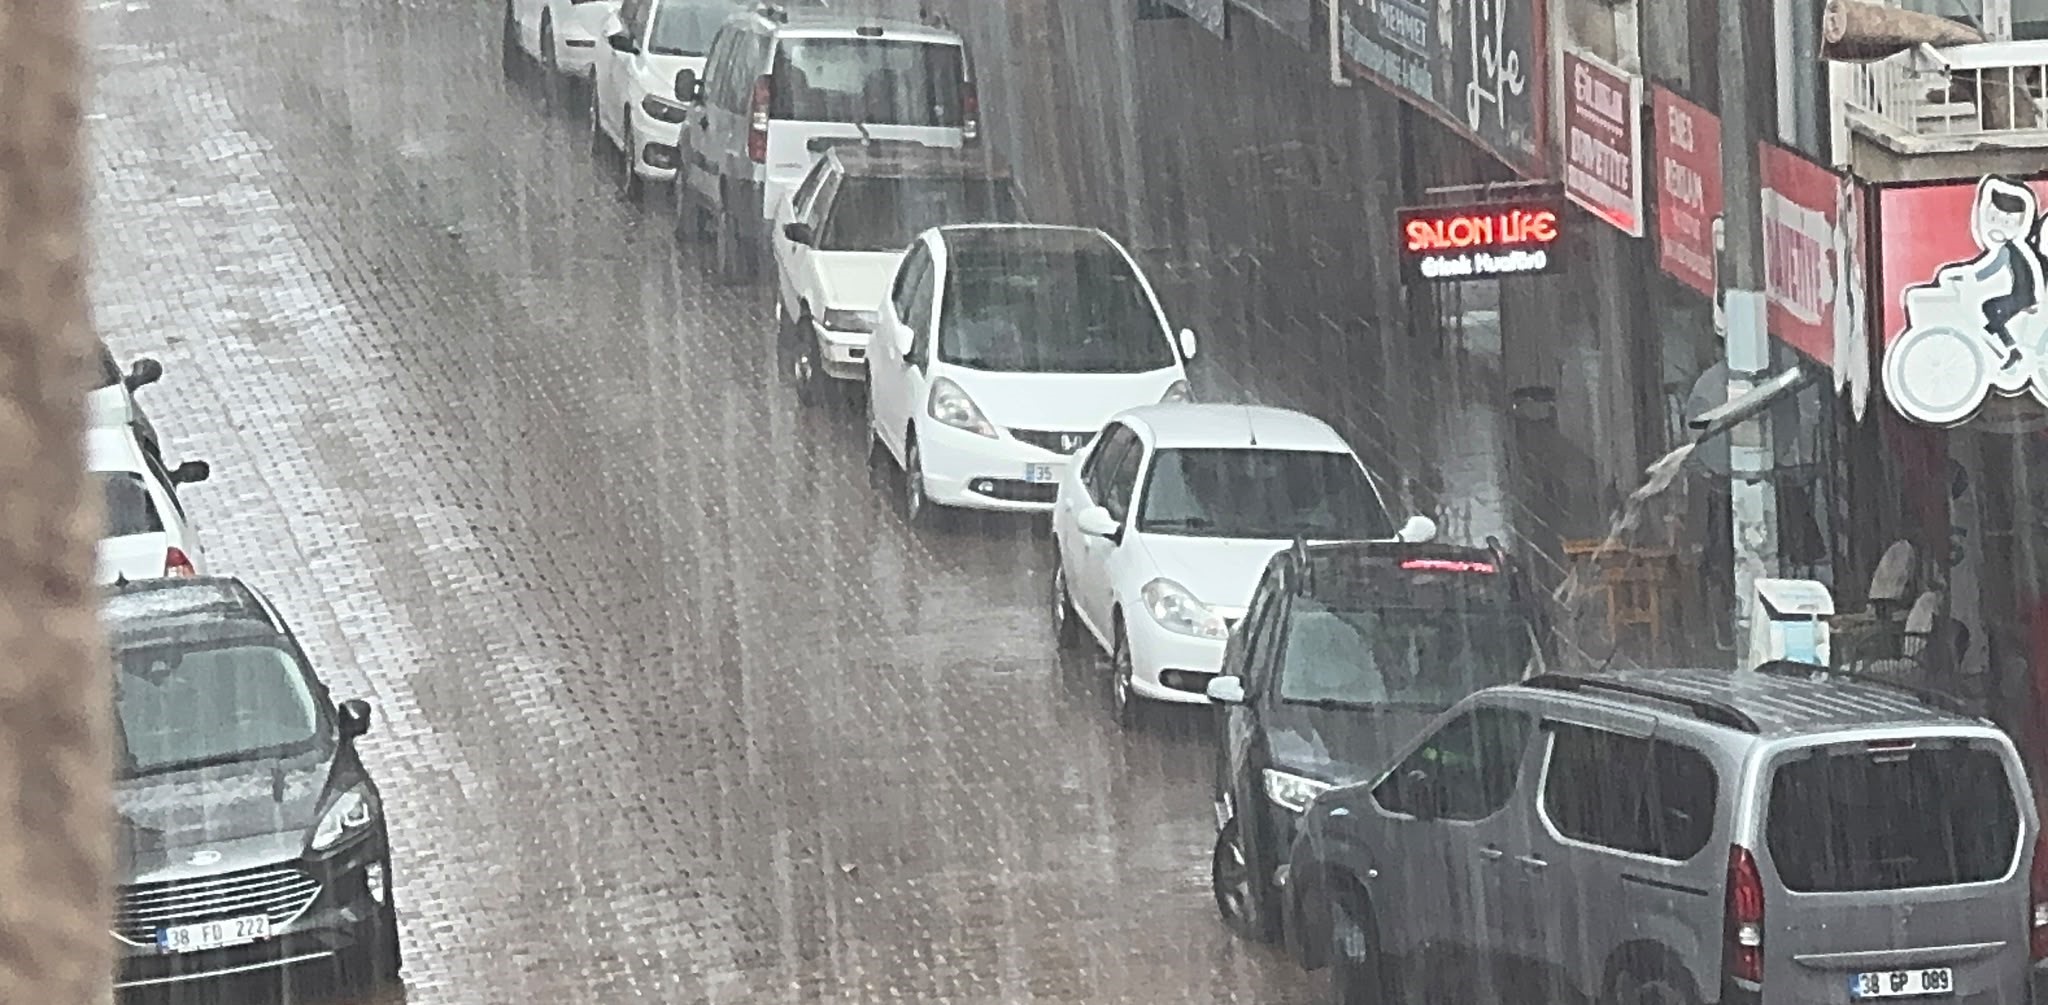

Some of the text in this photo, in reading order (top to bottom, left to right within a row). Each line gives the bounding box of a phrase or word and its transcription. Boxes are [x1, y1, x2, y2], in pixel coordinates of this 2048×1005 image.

[1467, 0, 1526, 132] Life
[1406, 215, 1493, 250] SALON
[1036, 466, 1053, 481] 35
[170, 928, 190, 947] 38
[235, 917, 264, 938] 222
[1861, 970, 1949, 994] 38 GP 089
